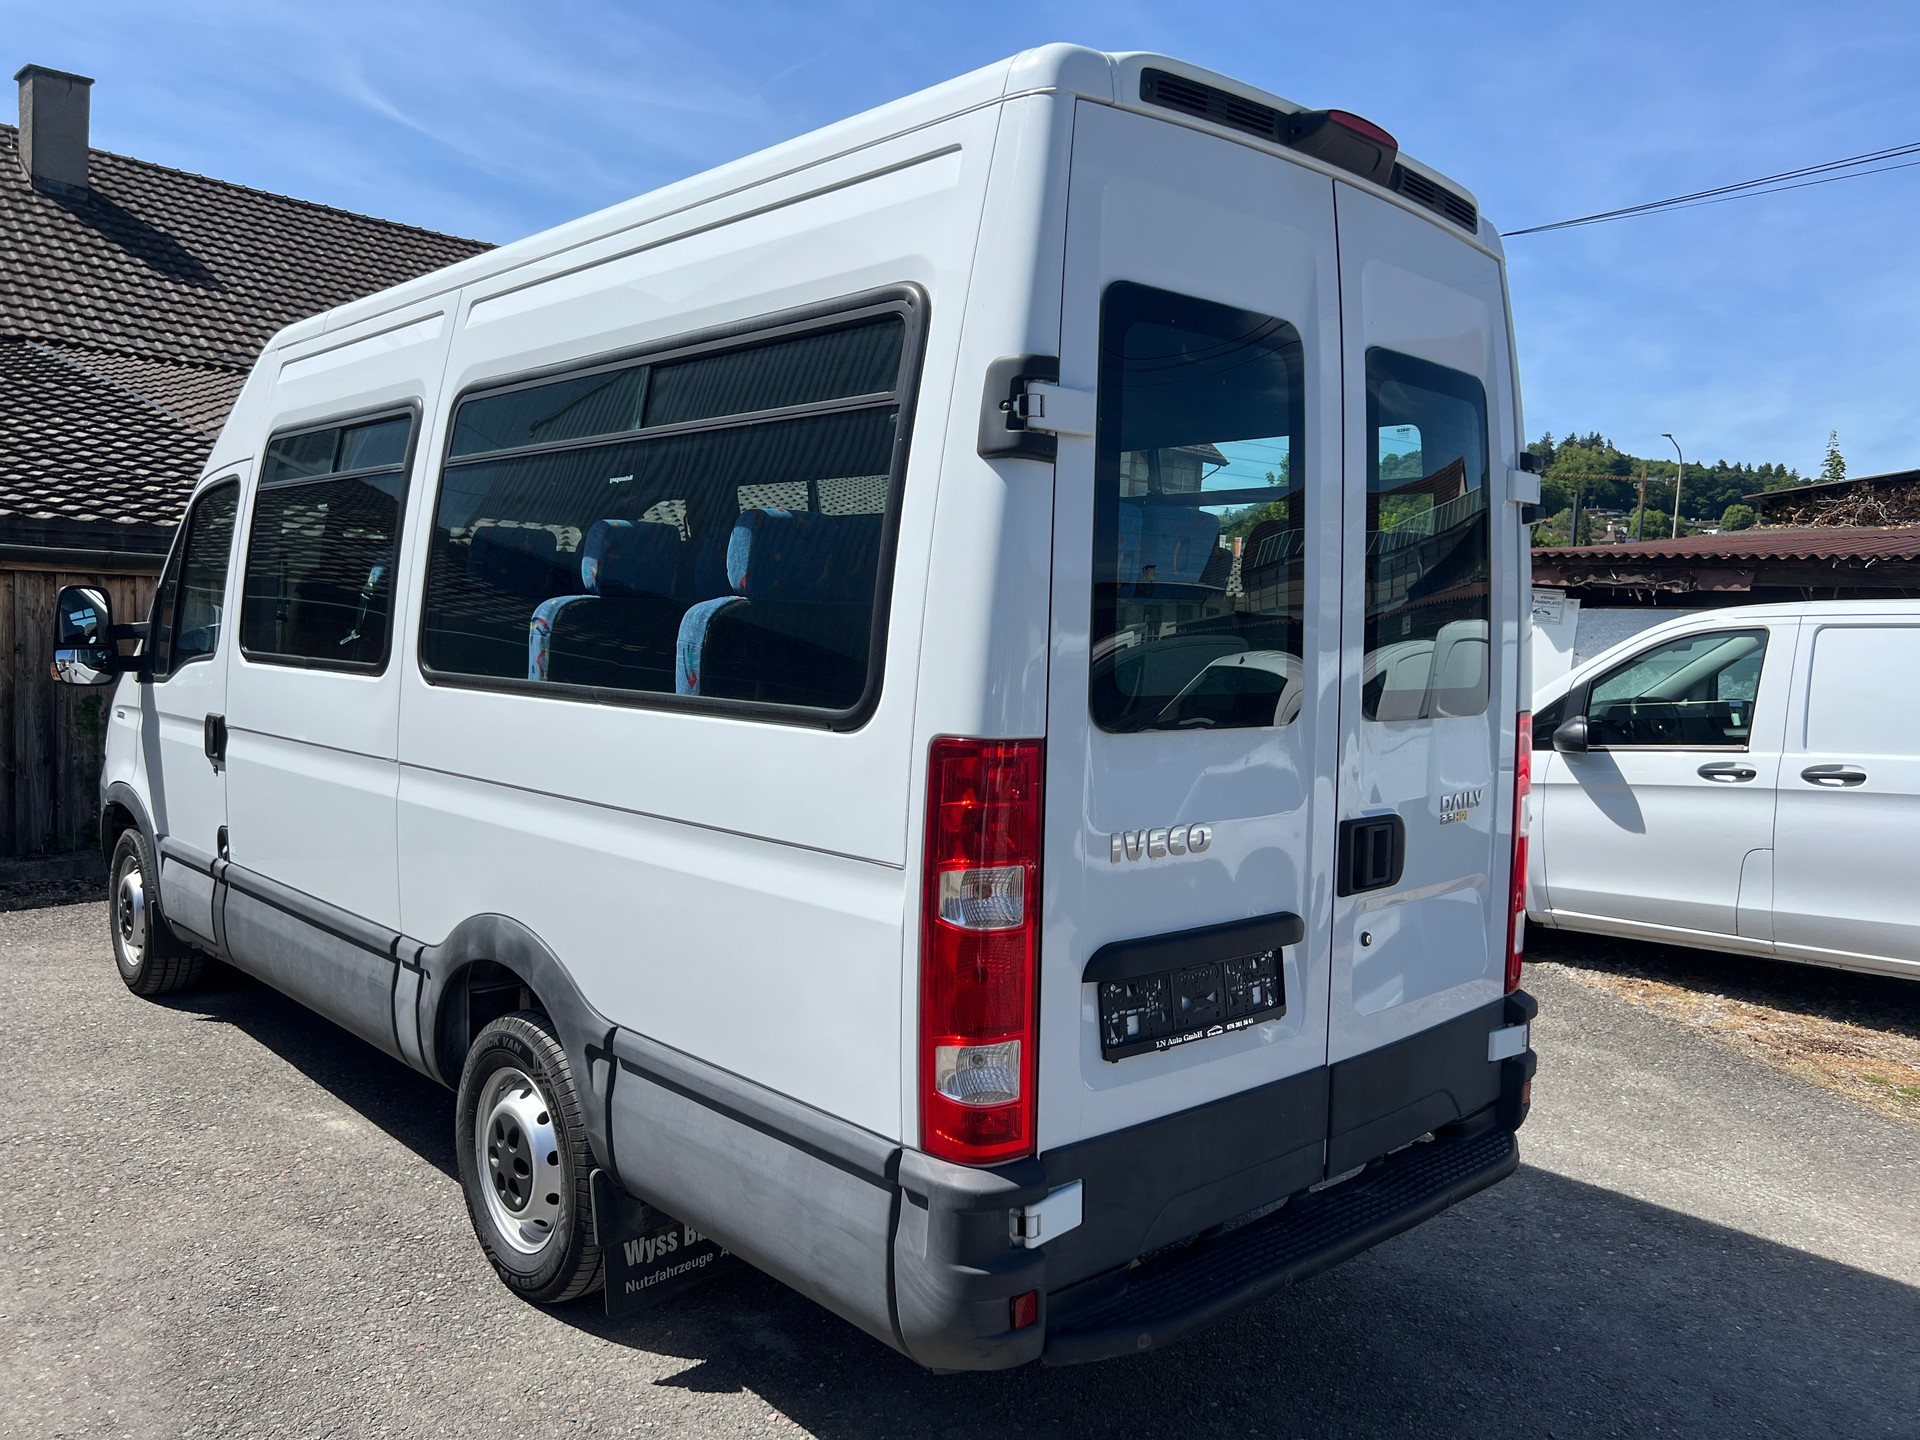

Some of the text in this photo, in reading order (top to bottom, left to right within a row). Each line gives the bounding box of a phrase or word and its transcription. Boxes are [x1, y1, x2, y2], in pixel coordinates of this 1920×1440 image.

[1440, 789, 1483, 813] DAILY
[1110, 823, 1212, 863] IVECO
[502, 1036, 522, 1054] VAN
[1167, 1037, 1183, 1045] Auto
[1183, 1031, 1203, 1041] GmbH
[623, 1231, 678, 1267] Wyss
[625, 1252, 714, 1294] Nutzfahrzeuge
